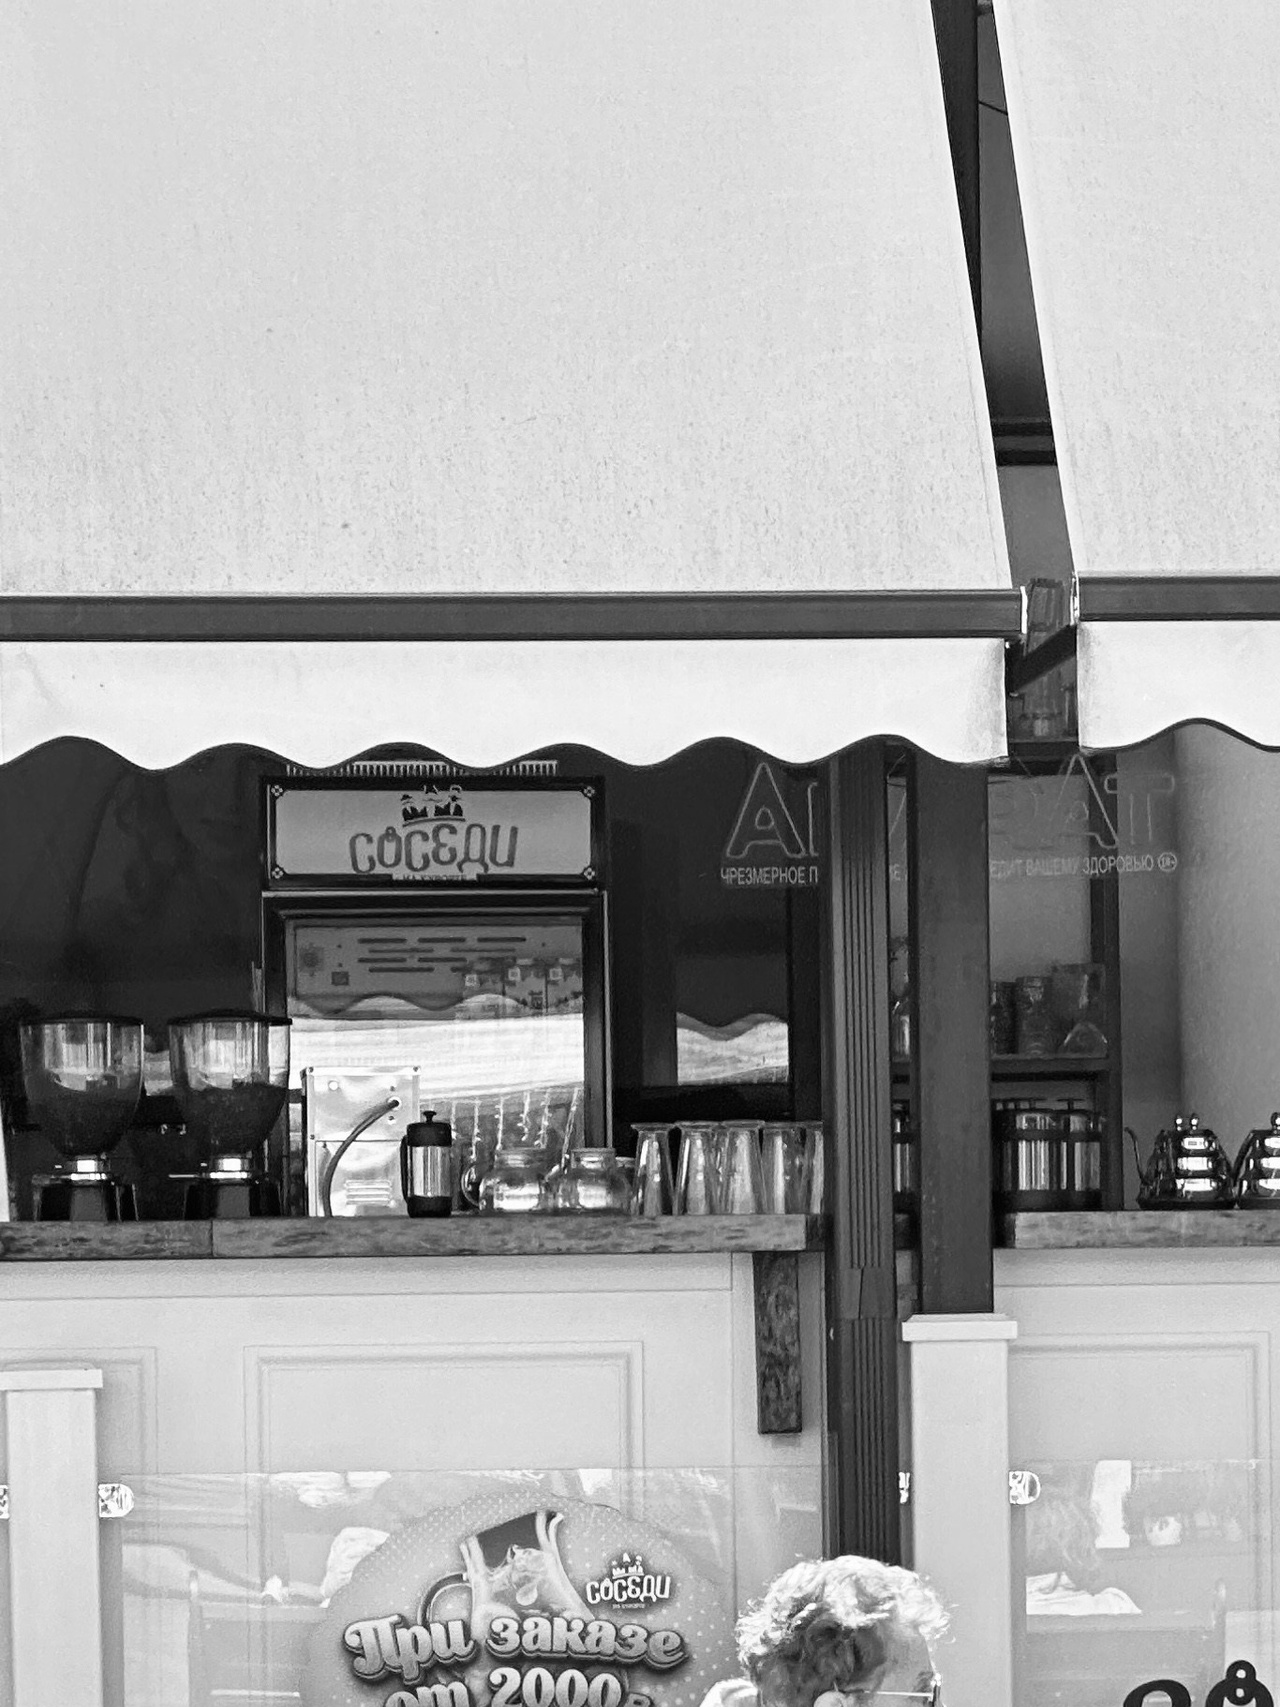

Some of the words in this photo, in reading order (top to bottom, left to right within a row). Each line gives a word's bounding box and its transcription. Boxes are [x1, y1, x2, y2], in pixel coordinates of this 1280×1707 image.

[349, 823, 519, 874] СОСЕДИ
[720, 865, 806, 885] ЧРЕЗМЕРНОЕ
[989, 859, 1022, 877] ЕДИТ
[1083, 855, 1154, 876] ЗДОРОВЬЮ
[586, 1574, 671, 1604] СОСЕДИ
[342, 1613, 476, 1684] При
[485, 1615, 689, 1670] заказе
